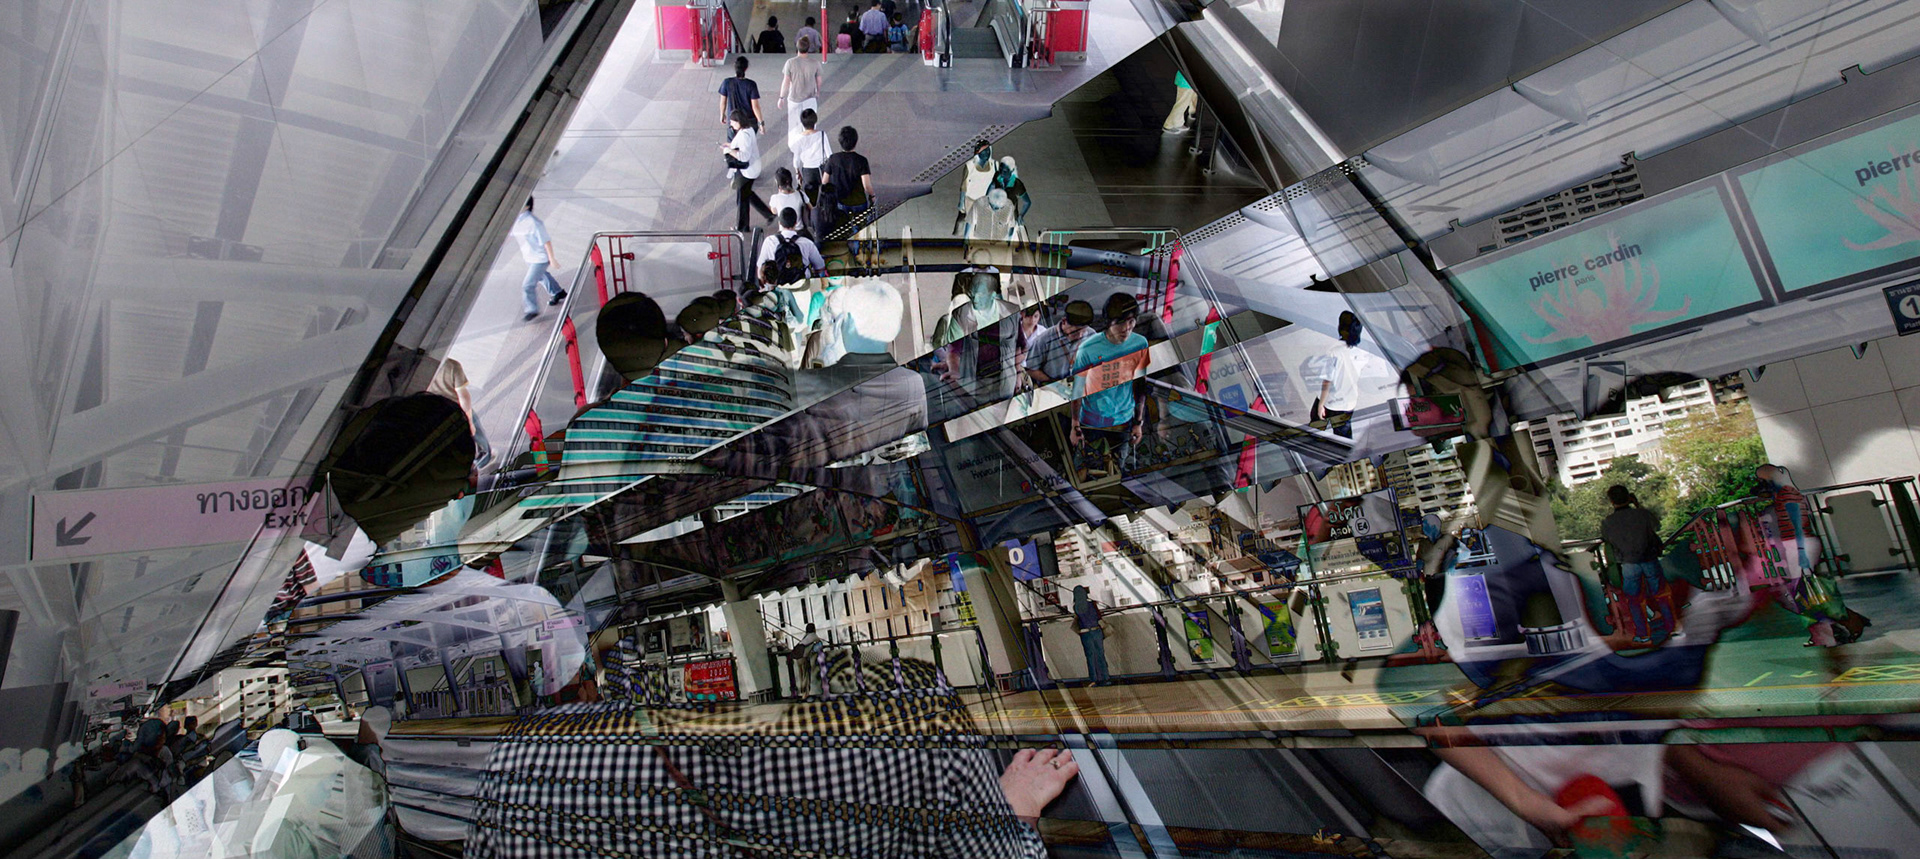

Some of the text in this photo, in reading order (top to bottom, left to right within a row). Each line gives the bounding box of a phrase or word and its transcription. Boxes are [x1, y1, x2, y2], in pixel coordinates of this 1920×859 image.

[1528, 243, 1643, 292] pierre cardin
[1574, 274, 1596, 287] paris
[1906, 297, 1920, 316] 1
[1222, 391, 1240, 401] NEW
[197, 486, 308, 514] ทางออก
[265, 510, 309, 529] Exit
[1328, 501, 1364, 523] อโศก
[1357, 522, 1369, 530] E4
